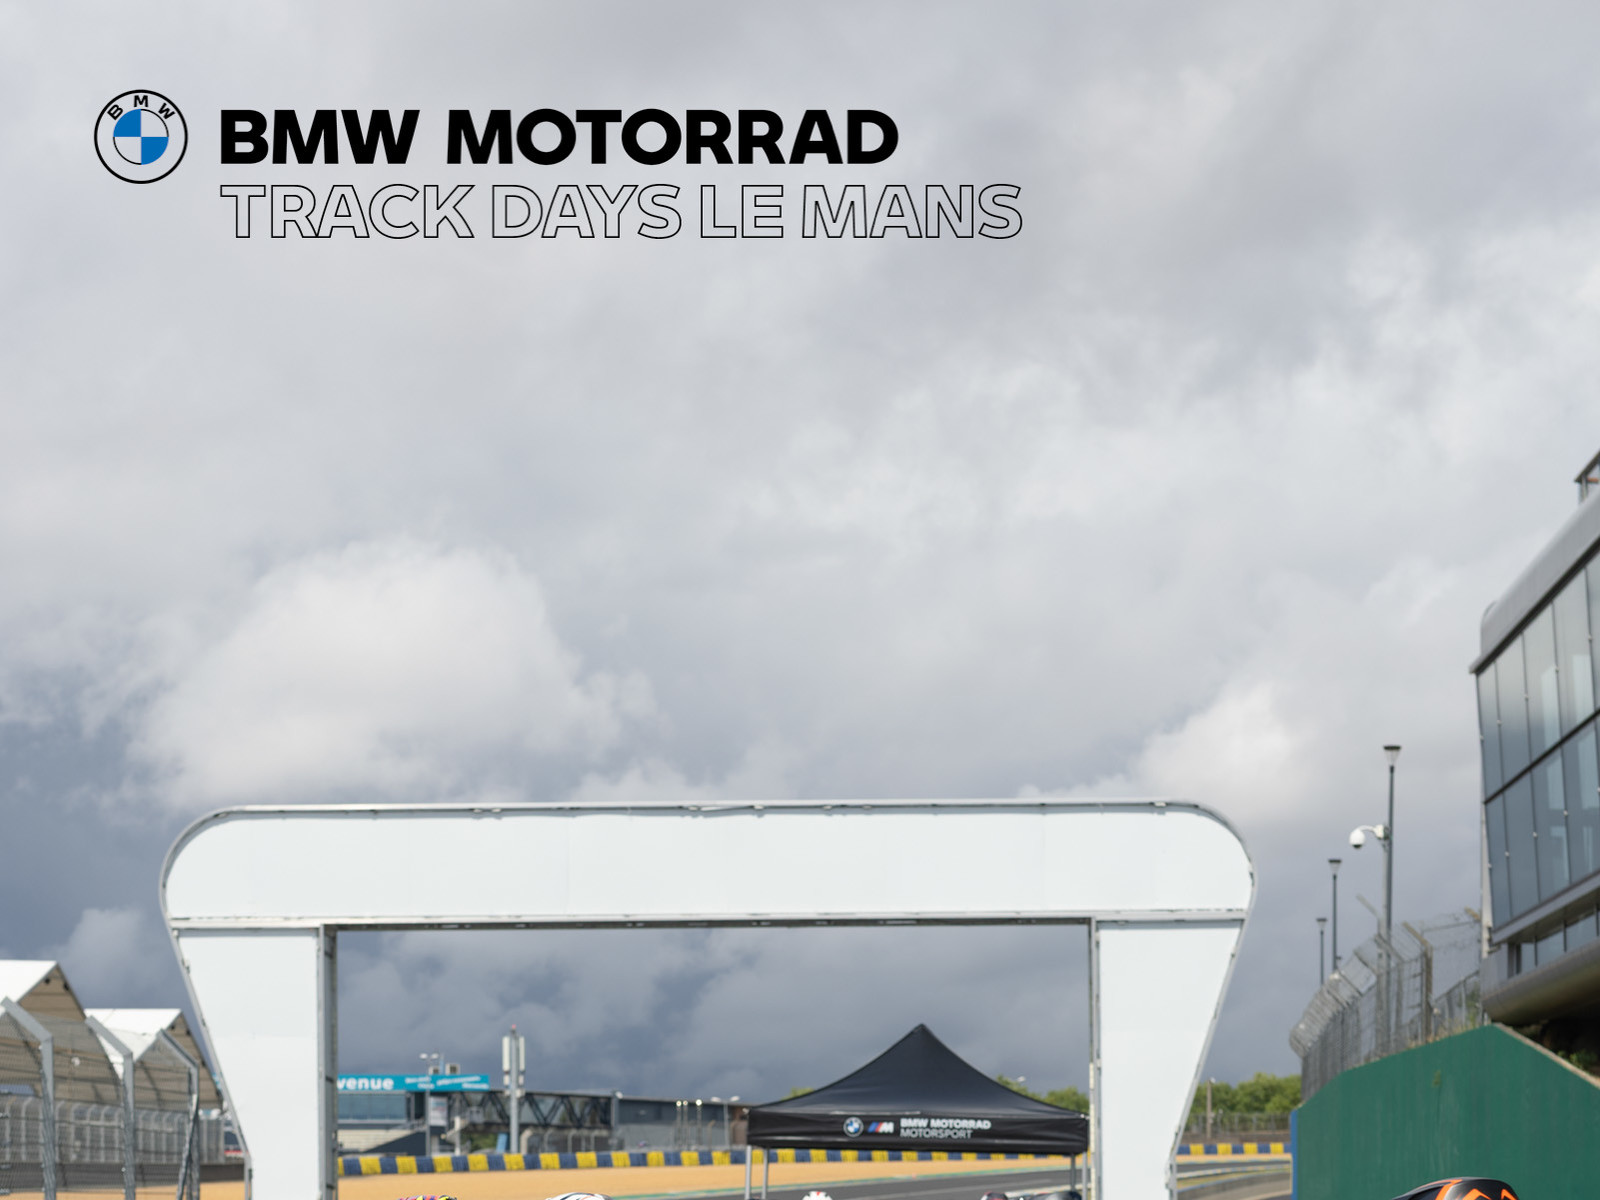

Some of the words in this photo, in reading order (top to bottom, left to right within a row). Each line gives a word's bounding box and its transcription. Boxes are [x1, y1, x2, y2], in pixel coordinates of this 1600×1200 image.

[900, 1118, 928, 1128] BMW
[930, 1119, 992, 1130] MOTORRAD
[900, 1128, 973, 1139] MOTORSPORT
